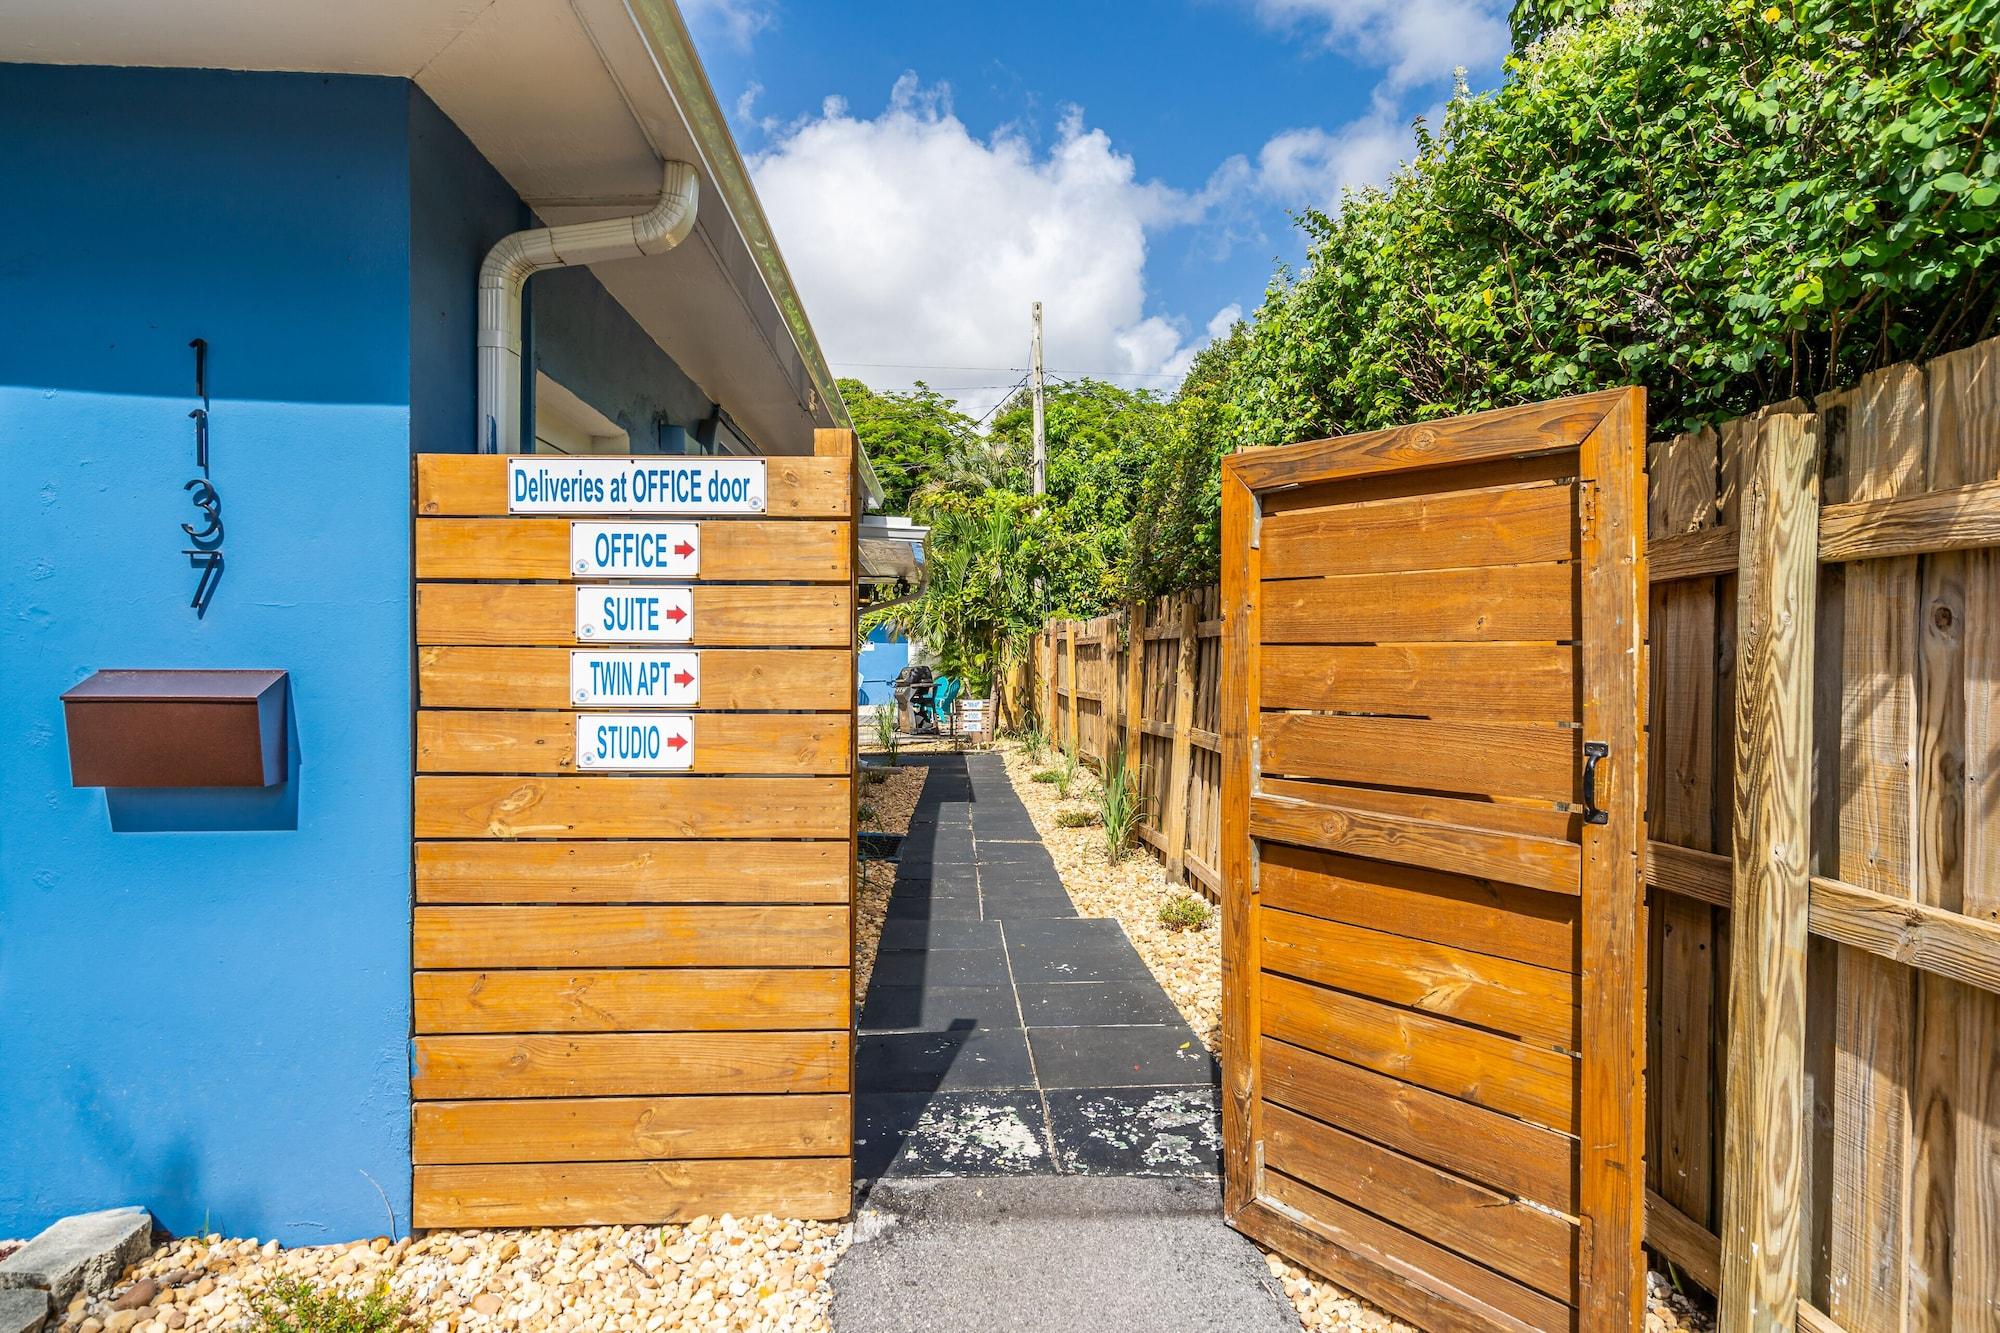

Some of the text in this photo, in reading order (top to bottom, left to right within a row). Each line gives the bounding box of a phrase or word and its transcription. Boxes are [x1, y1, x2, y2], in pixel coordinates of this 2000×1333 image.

[181, 338, 222, 609] 1137
[514, 468, 751, 503] Deliveries at OFFICE door
[594, 532, 668, 569] OFFICE
[603, 596, 660, 632] SUITE
[589, 660, 671, 697] TWIN APT
[596, 724, 661, 760] STUDIO
